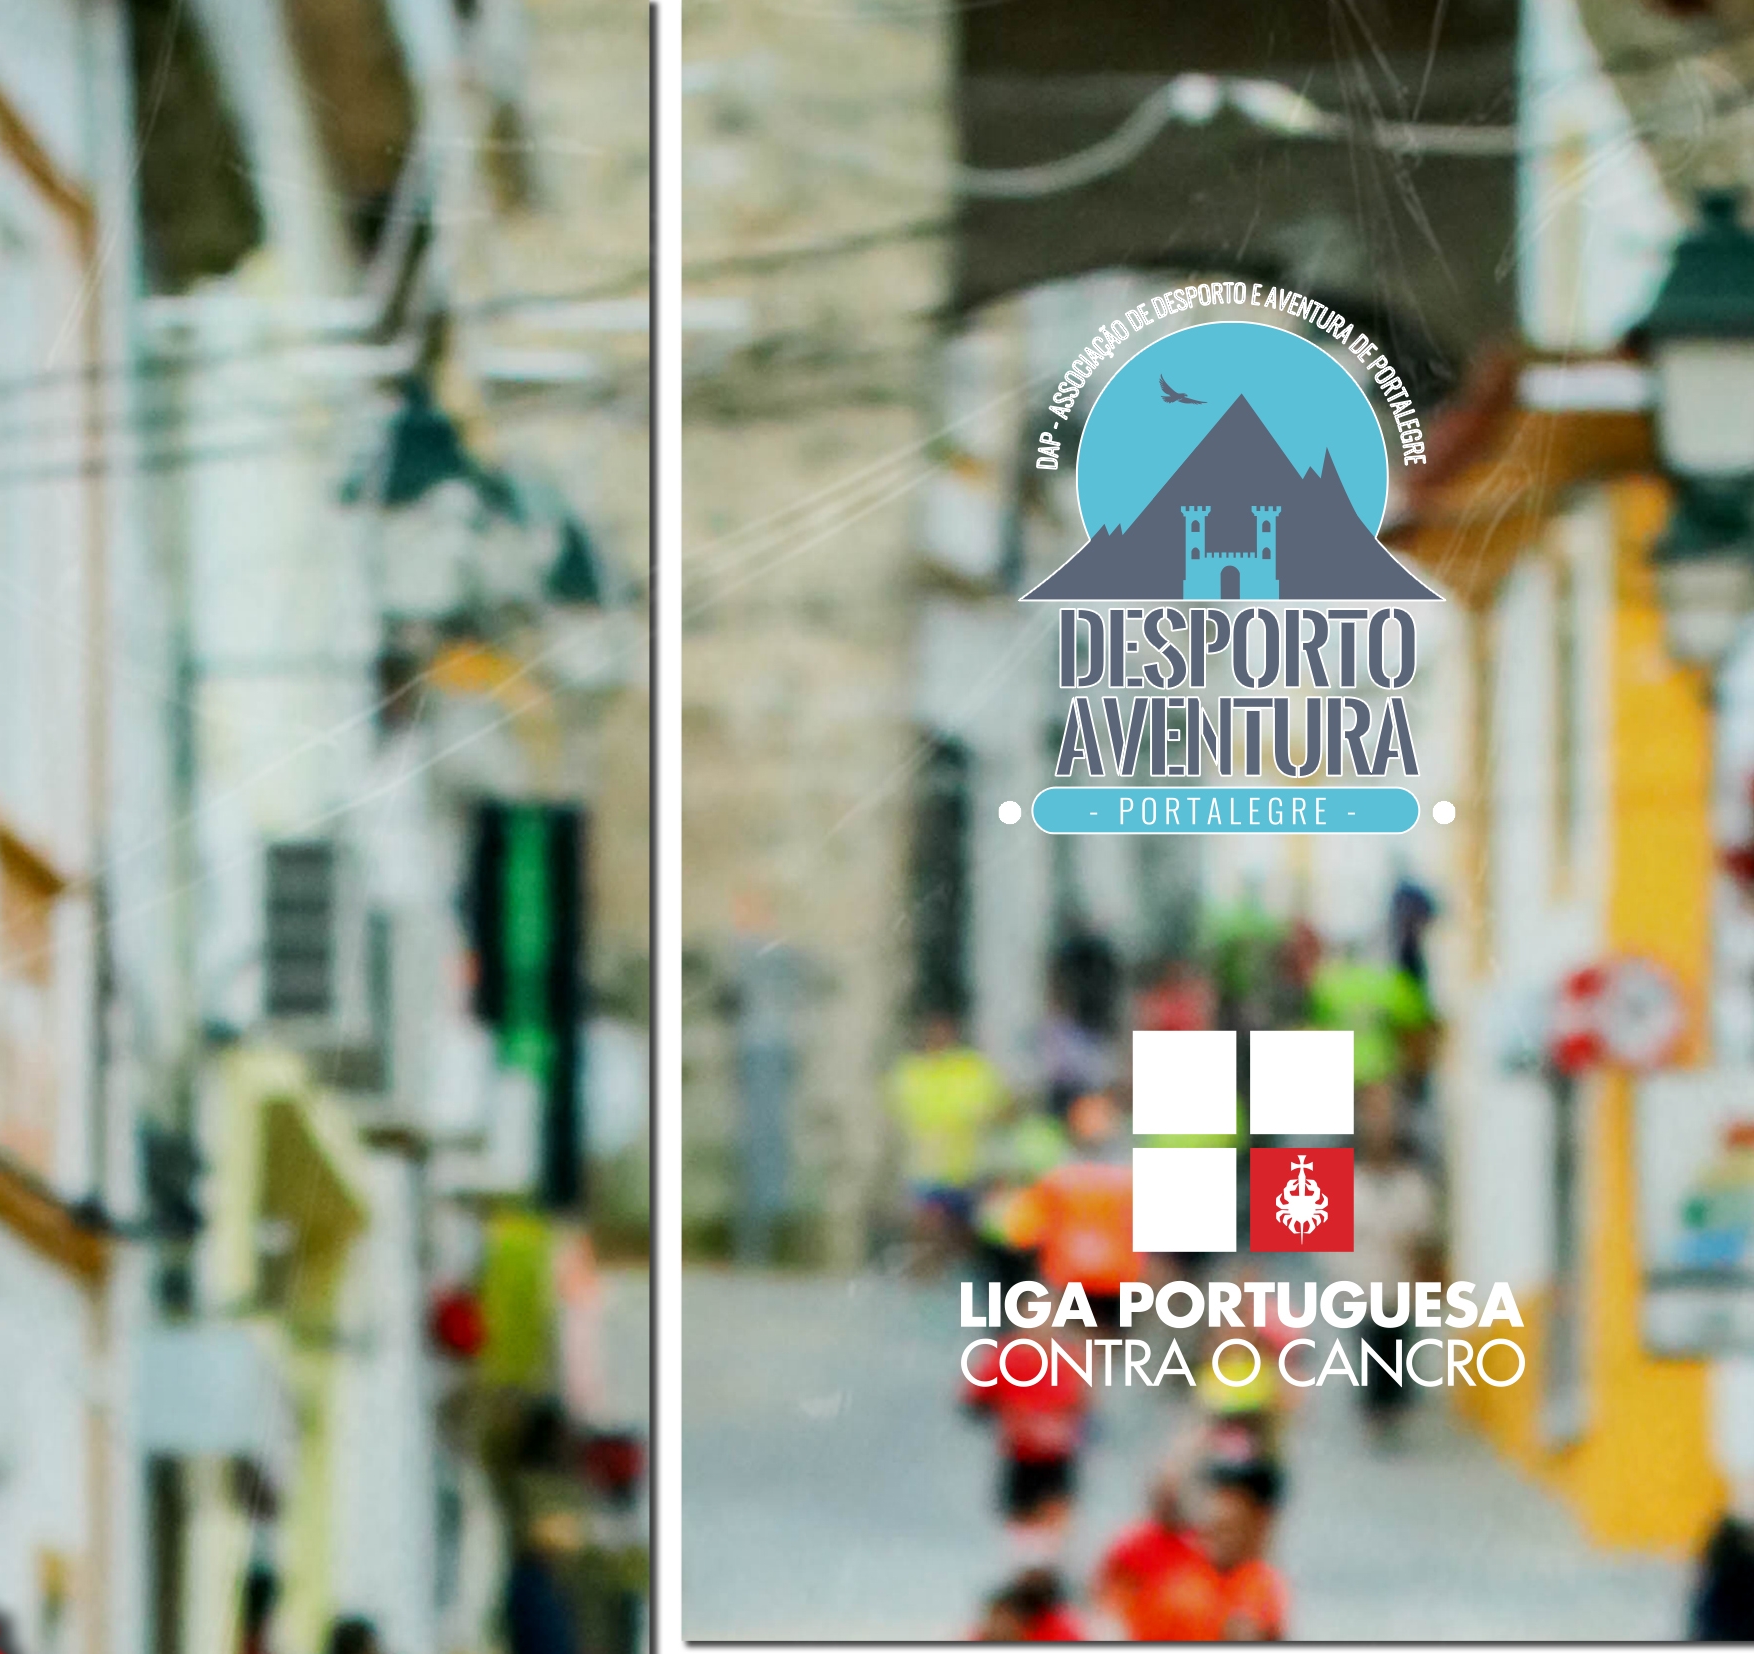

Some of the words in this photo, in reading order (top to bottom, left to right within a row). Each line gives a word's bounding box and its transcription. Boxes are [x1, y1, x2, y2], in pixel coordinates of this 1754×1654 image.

[1036, 431, 1061, 470] DAP
[1049, 319, 1130, 420] ASSOCIAÇÃO
[1125, 302, 1154, 332] DE
[1151, 282, 1247, 319] DESPORTO
[1251, 283, 1263, 306] E
[1264, 286, 1354, 344] AVENTURA
[1348, 333, 1378, 363] DE
[1367, 354, 1427, 466] PORTALEGRE
[1059, 606, 1417, 690] DESPORTO
[1055, 696, 1420, 778] AVENTURA
[961, 1281, 1097, 1328] LIGA
[1120, 1280, 1525, 1329] PORTUGUESA
[961, 1338, 1196, 1387] CONTRA
[1212, 1338, 1261, 1387] O
[1279, 1338, 1526, 1387] CANCRO
